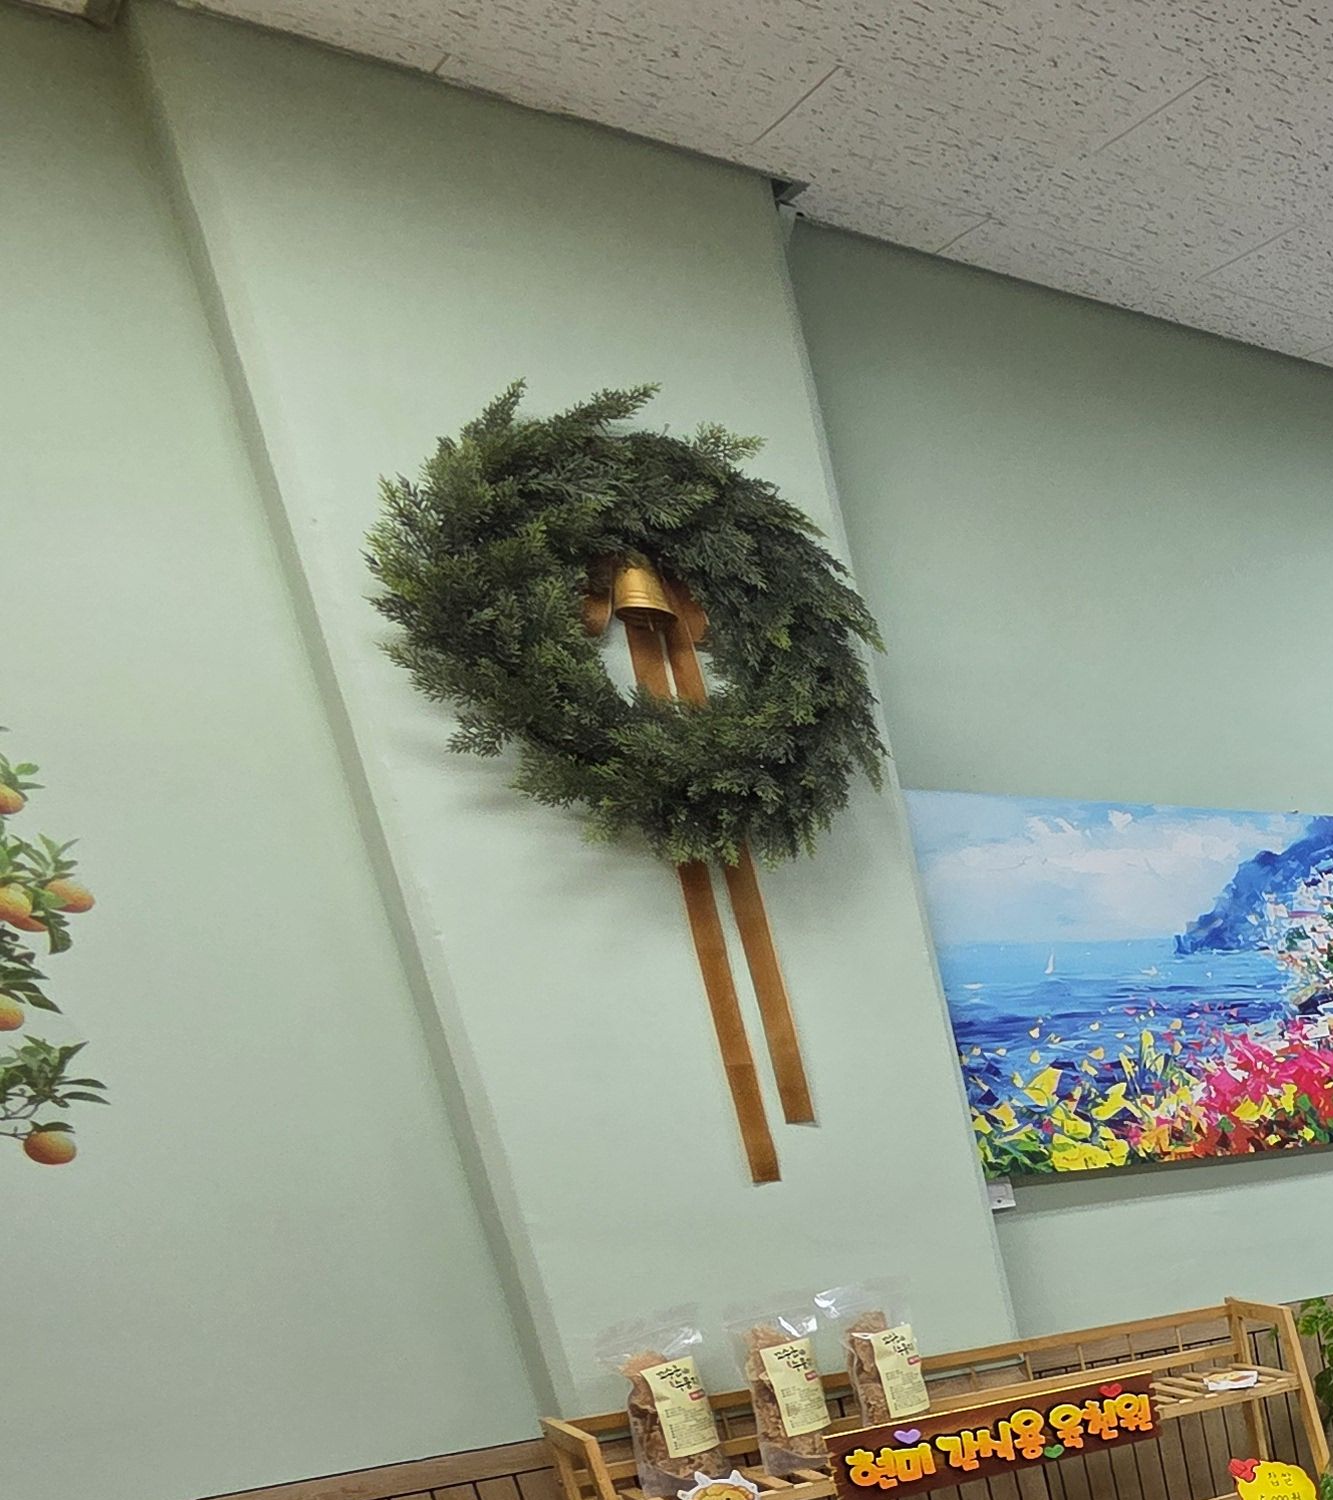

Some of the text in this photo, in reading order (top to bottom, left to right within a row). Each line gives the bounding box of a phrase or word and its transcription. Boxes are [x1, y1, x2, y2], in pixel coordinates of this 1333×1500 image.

[845, 1392, 1154, 1490] 현미 간식용 육천원
